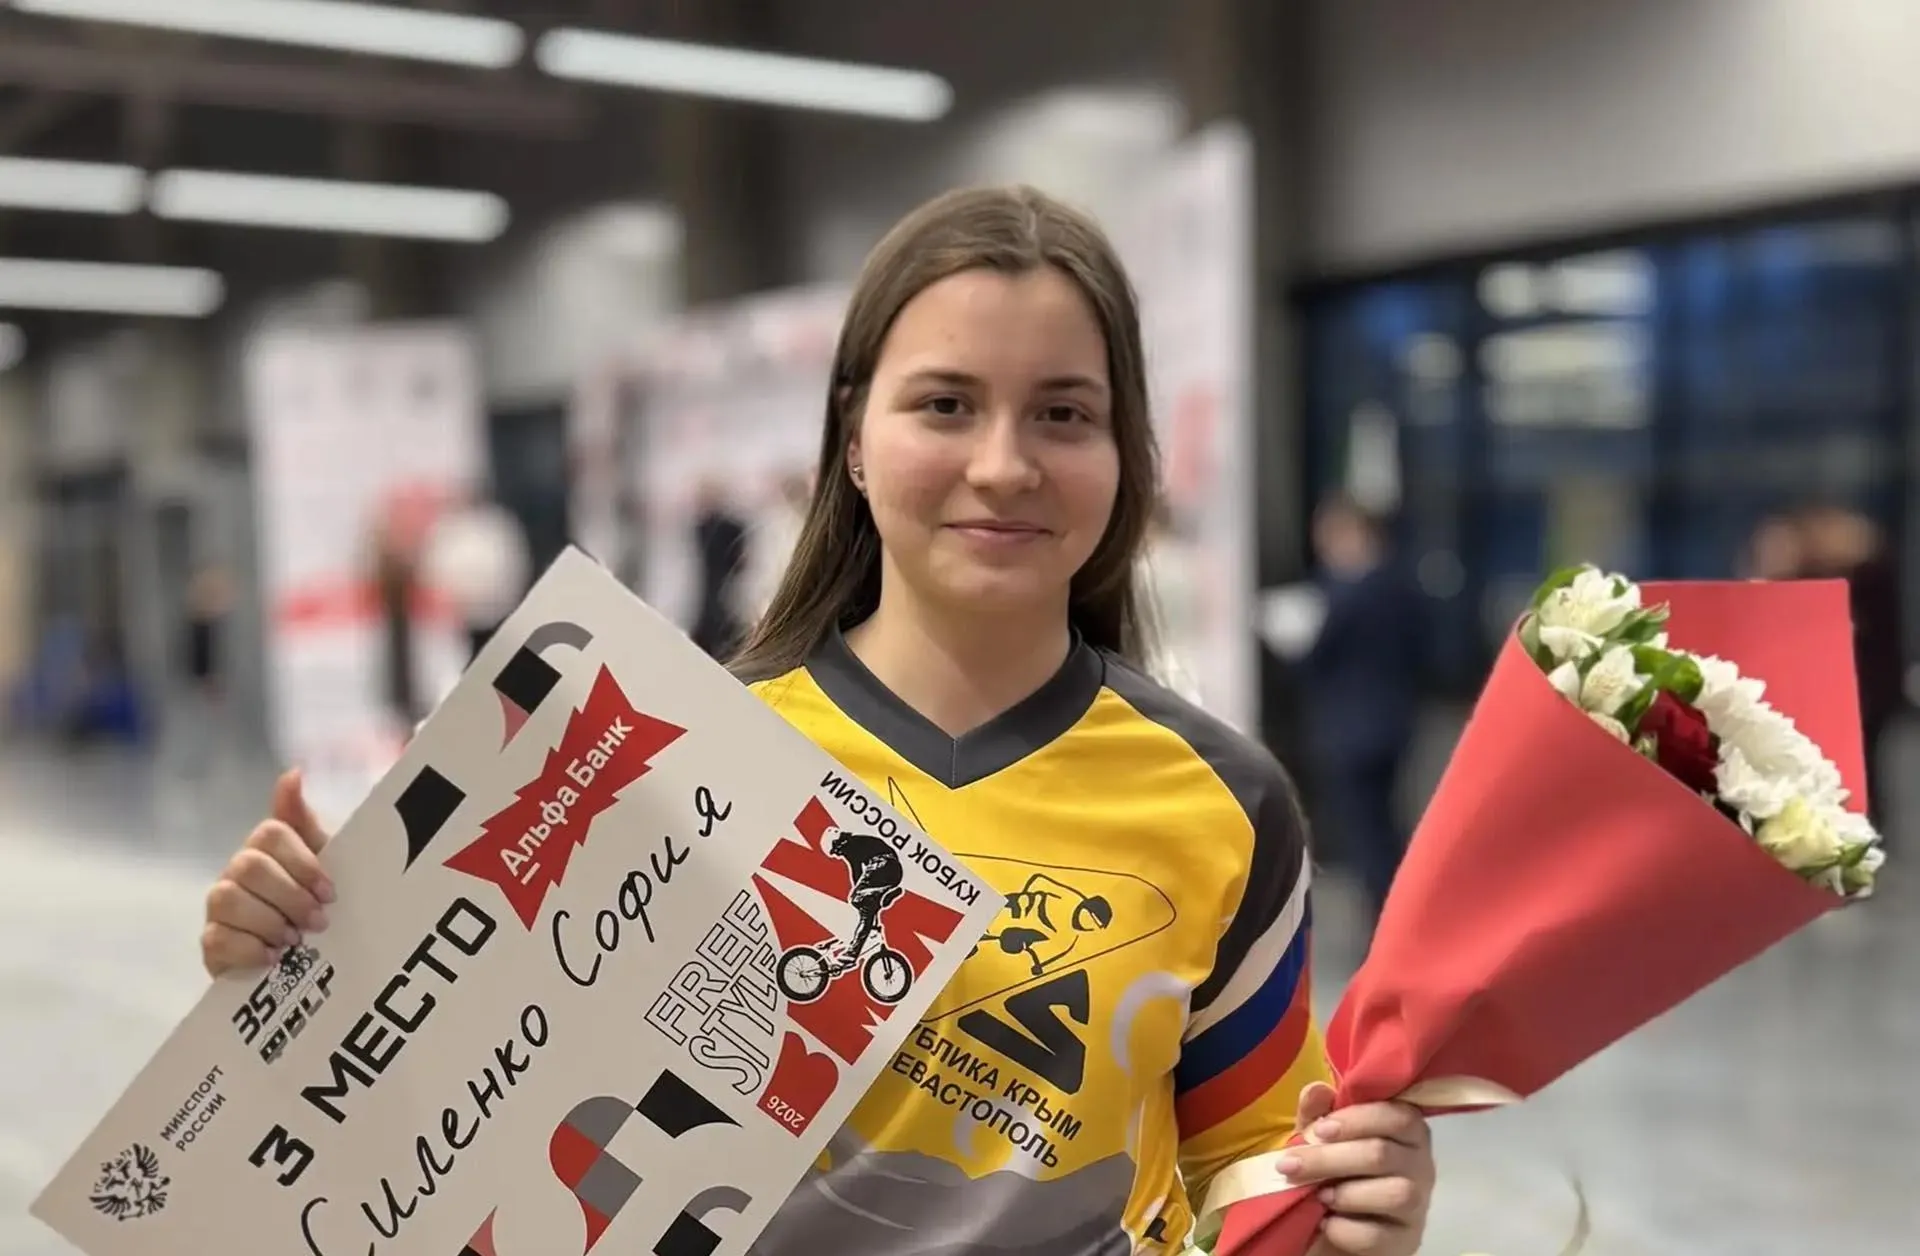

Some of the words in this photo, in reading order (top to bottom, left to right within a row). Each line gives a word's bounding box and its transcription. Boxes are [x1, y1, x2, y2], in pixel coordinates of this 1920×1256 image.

[499, 785, 579, 878] Альфа
[565, 715, 635, 788] Банк
[819, 771, 913, 851] РОССИИ
[907, 841, 981, 907] КУБОК
[644, 889, 768, 1045] FREE
[231, 975, 277, 1046] 35
[248, 1124, 314, 1186] 3
[301, 897, 496, 1123] МЕСТО
[301, 1004, 549, 1256] Силенко
[553, 786, 732, 986] София
[689, 941, 778, 1095] STYLE
[160, 1064, 224, 1141] МИНСПОРТ
[175, 1093, 227, 1152] РОССИИ
[766, 1095, 805, 1129] 2026
[891, 1051, 1060, 1169] ЕВАСТОПОЛЬ
[1003, 1078, 1082, 1141] КРЫМ
